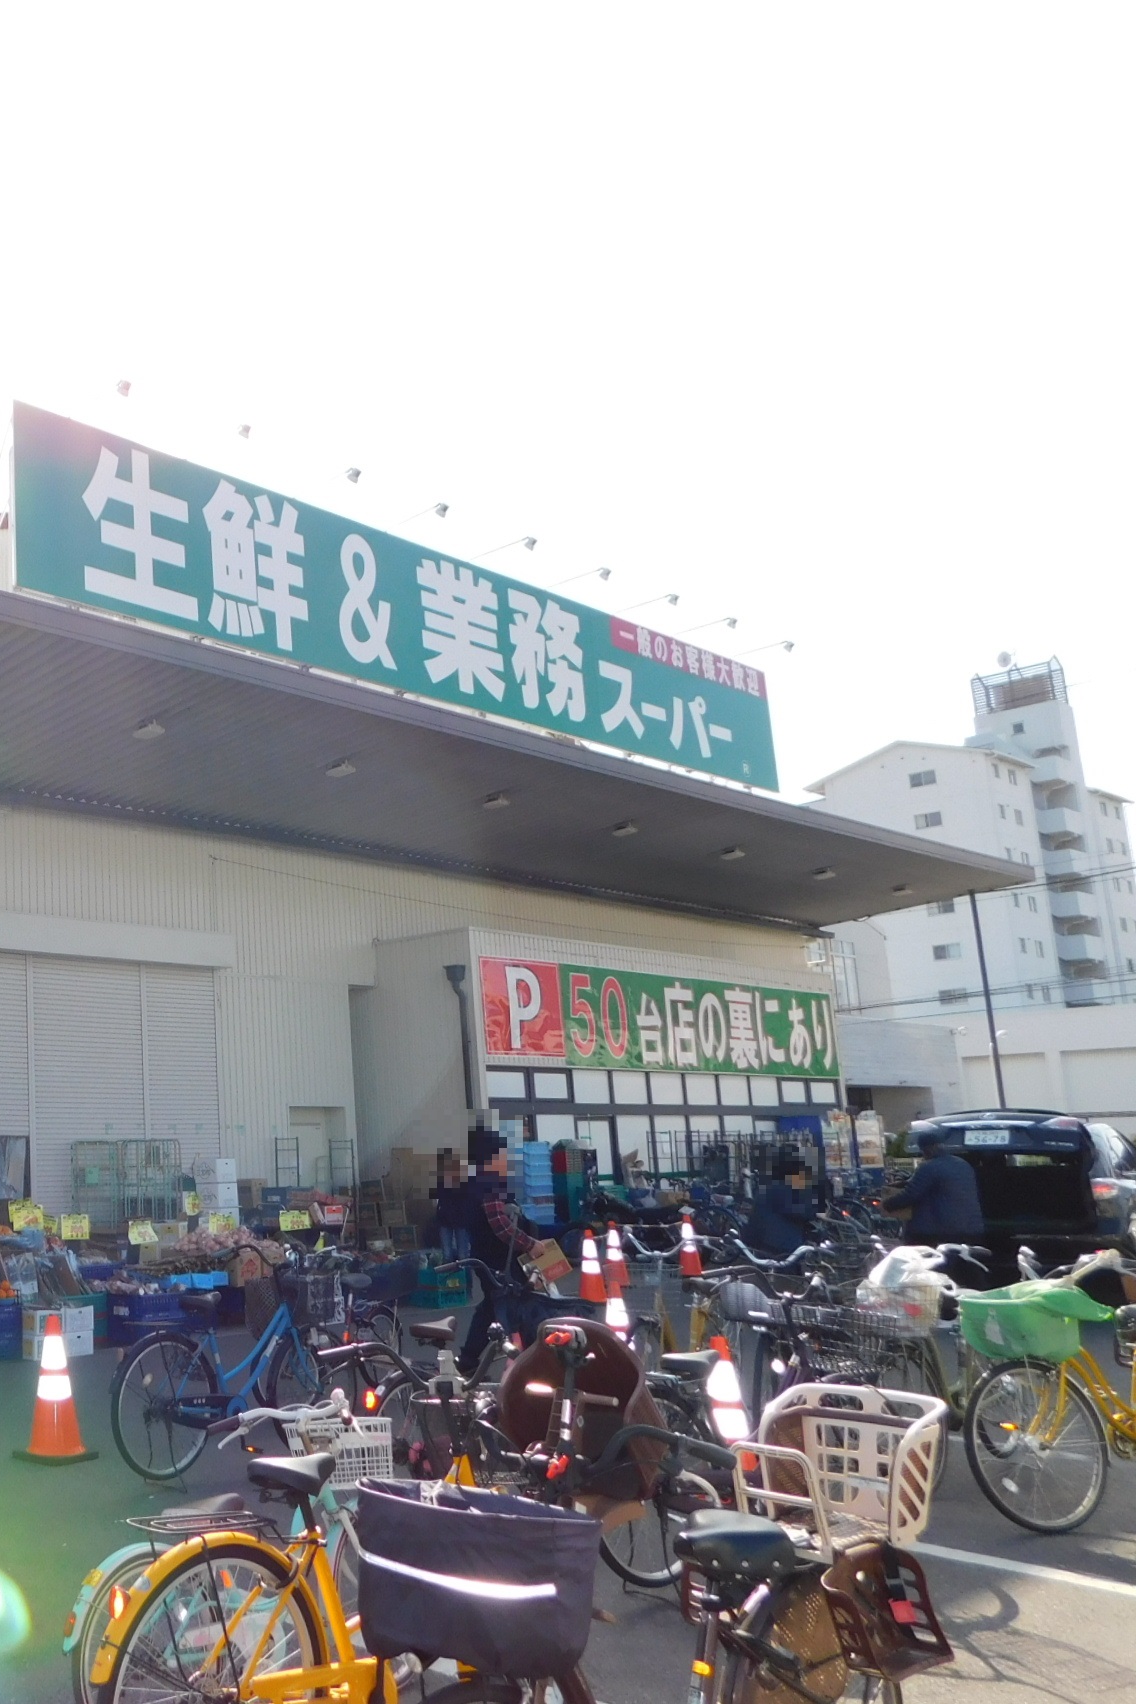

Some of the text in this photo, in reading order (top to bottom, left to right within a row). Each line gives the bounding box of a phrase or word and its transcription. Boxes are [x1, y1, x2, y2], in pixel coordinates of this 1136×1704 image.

[619, 626, 760, 697] 一般のお客様大歓迎
[505, 966, 542, 1049] P
